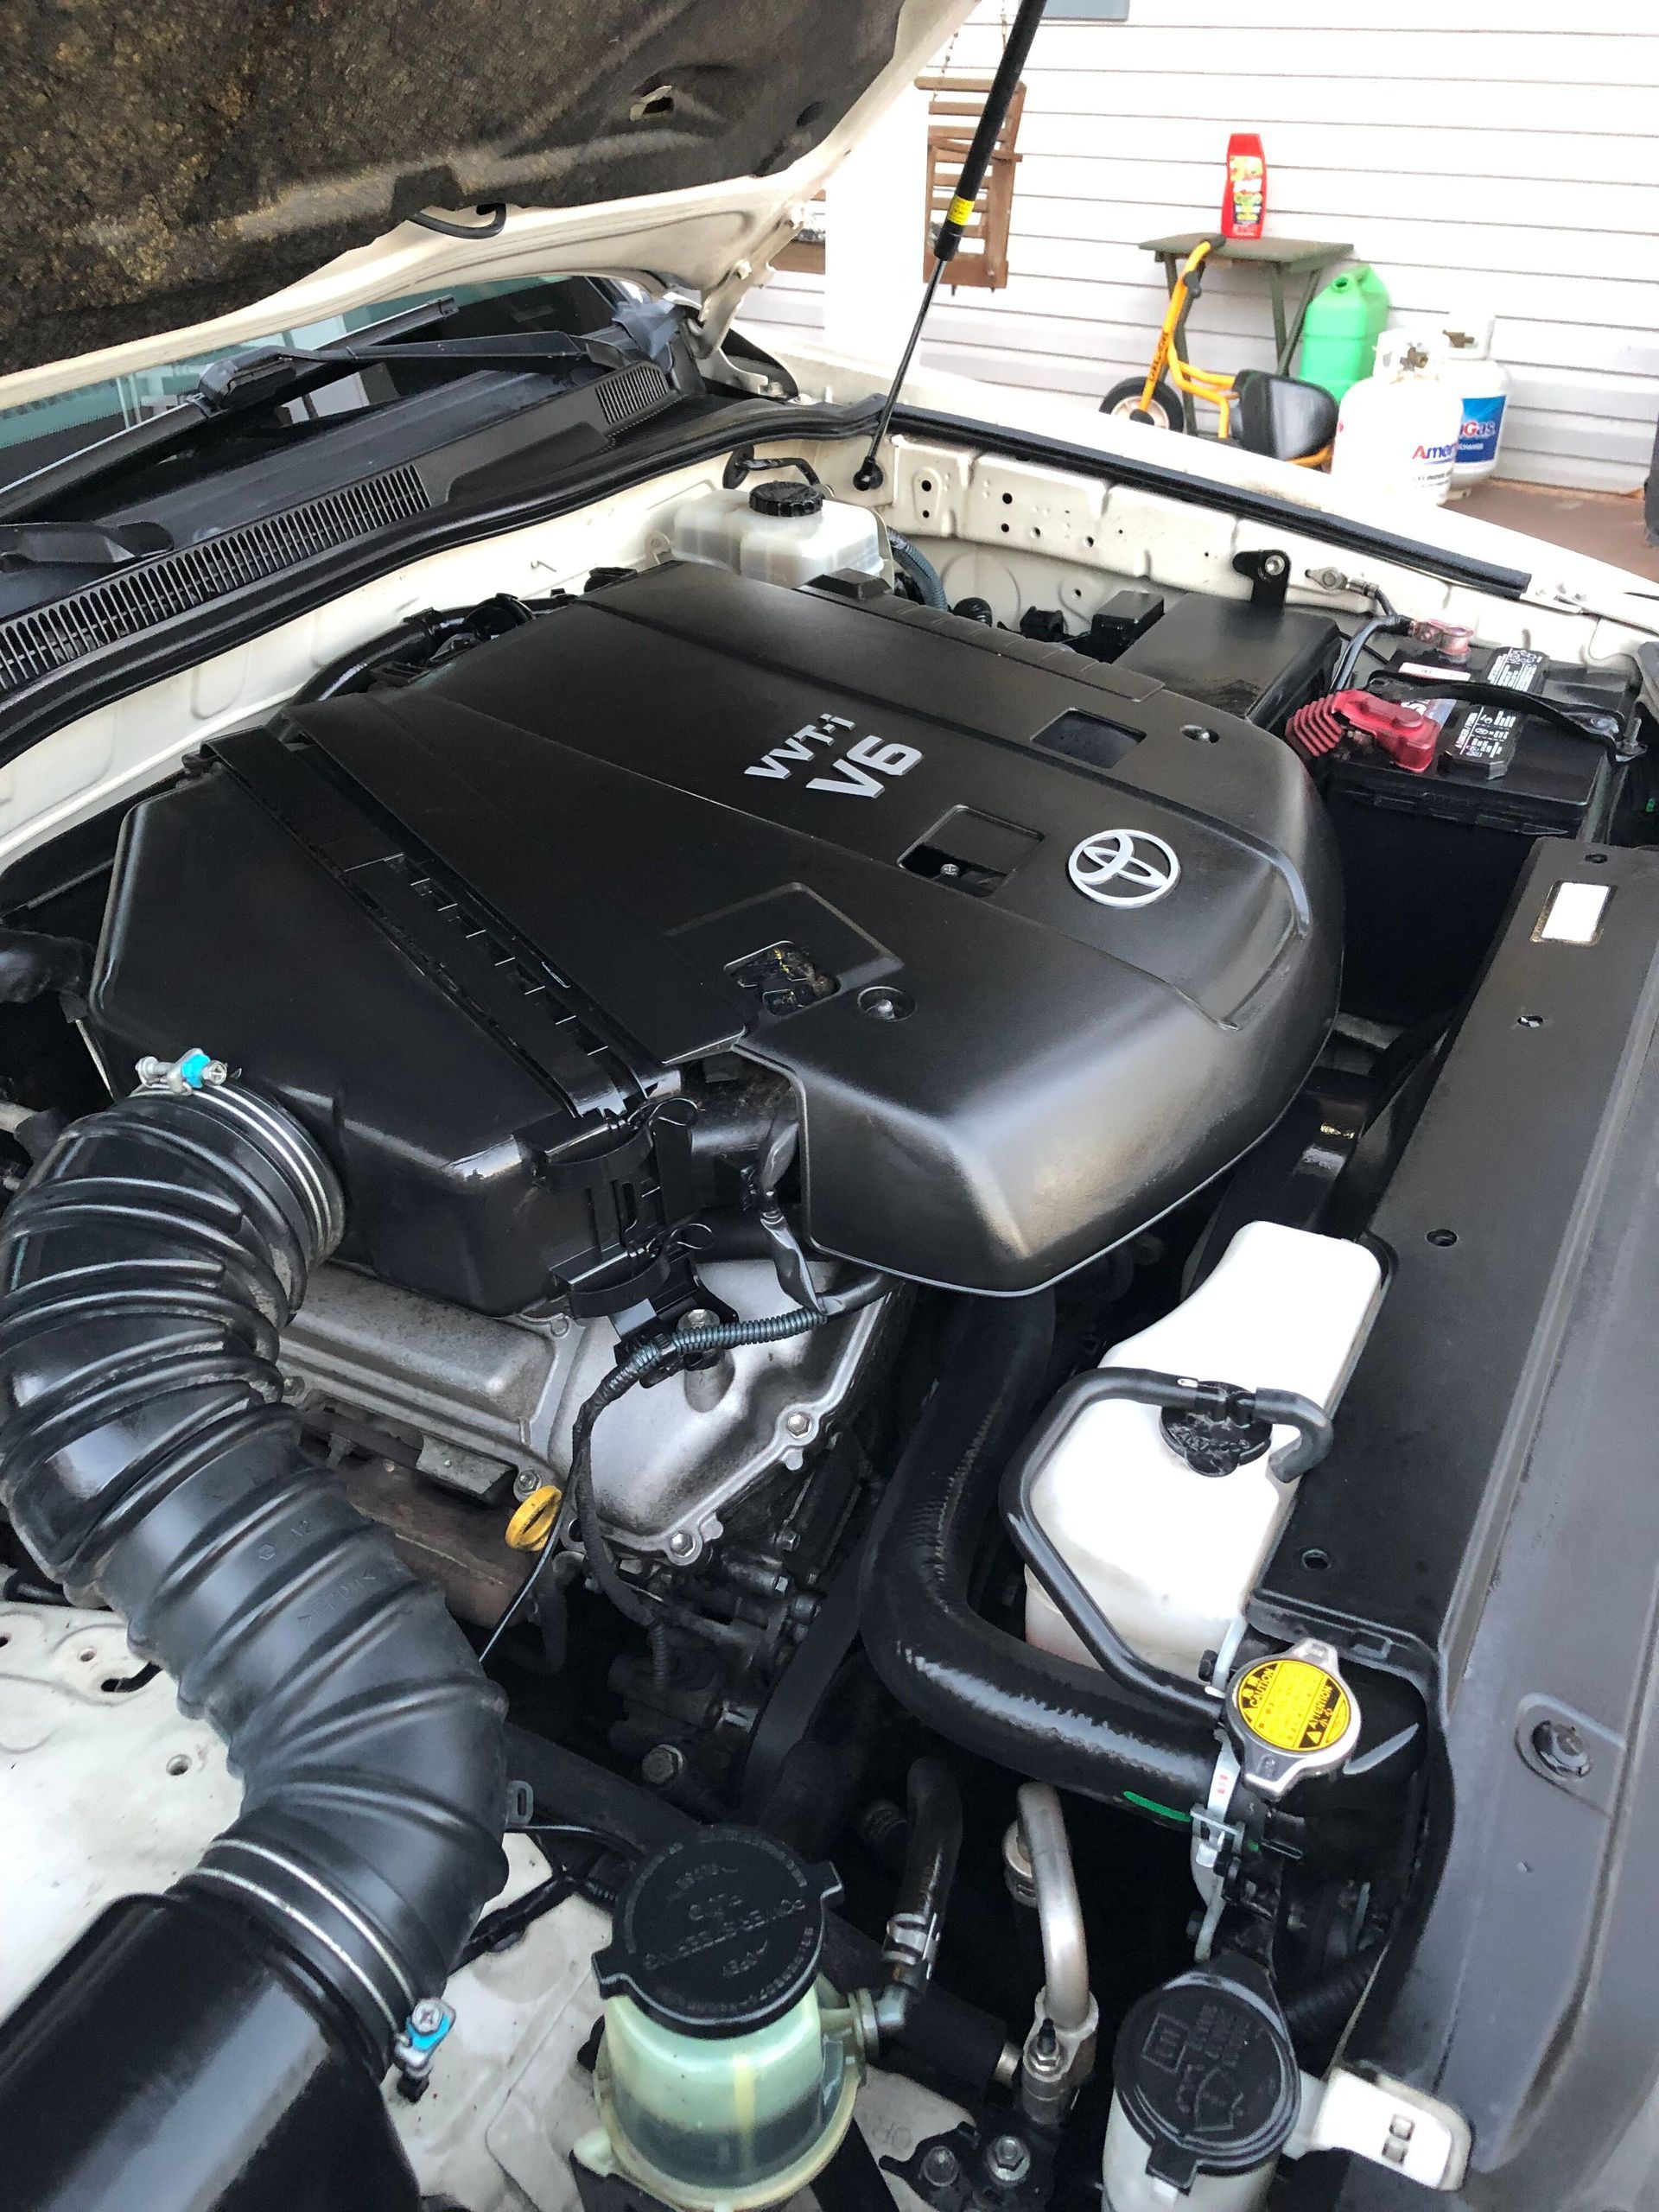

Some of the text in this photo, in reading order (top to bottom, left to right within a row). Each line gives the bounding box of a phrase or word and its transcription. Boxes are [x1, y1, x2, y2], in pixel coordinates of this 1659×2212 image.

[805, 734, 923, 798] V6
[1249, 1668, 1274, 1707] CAUTION
[1307, 1686, 1333, 1728] ATTENTION
